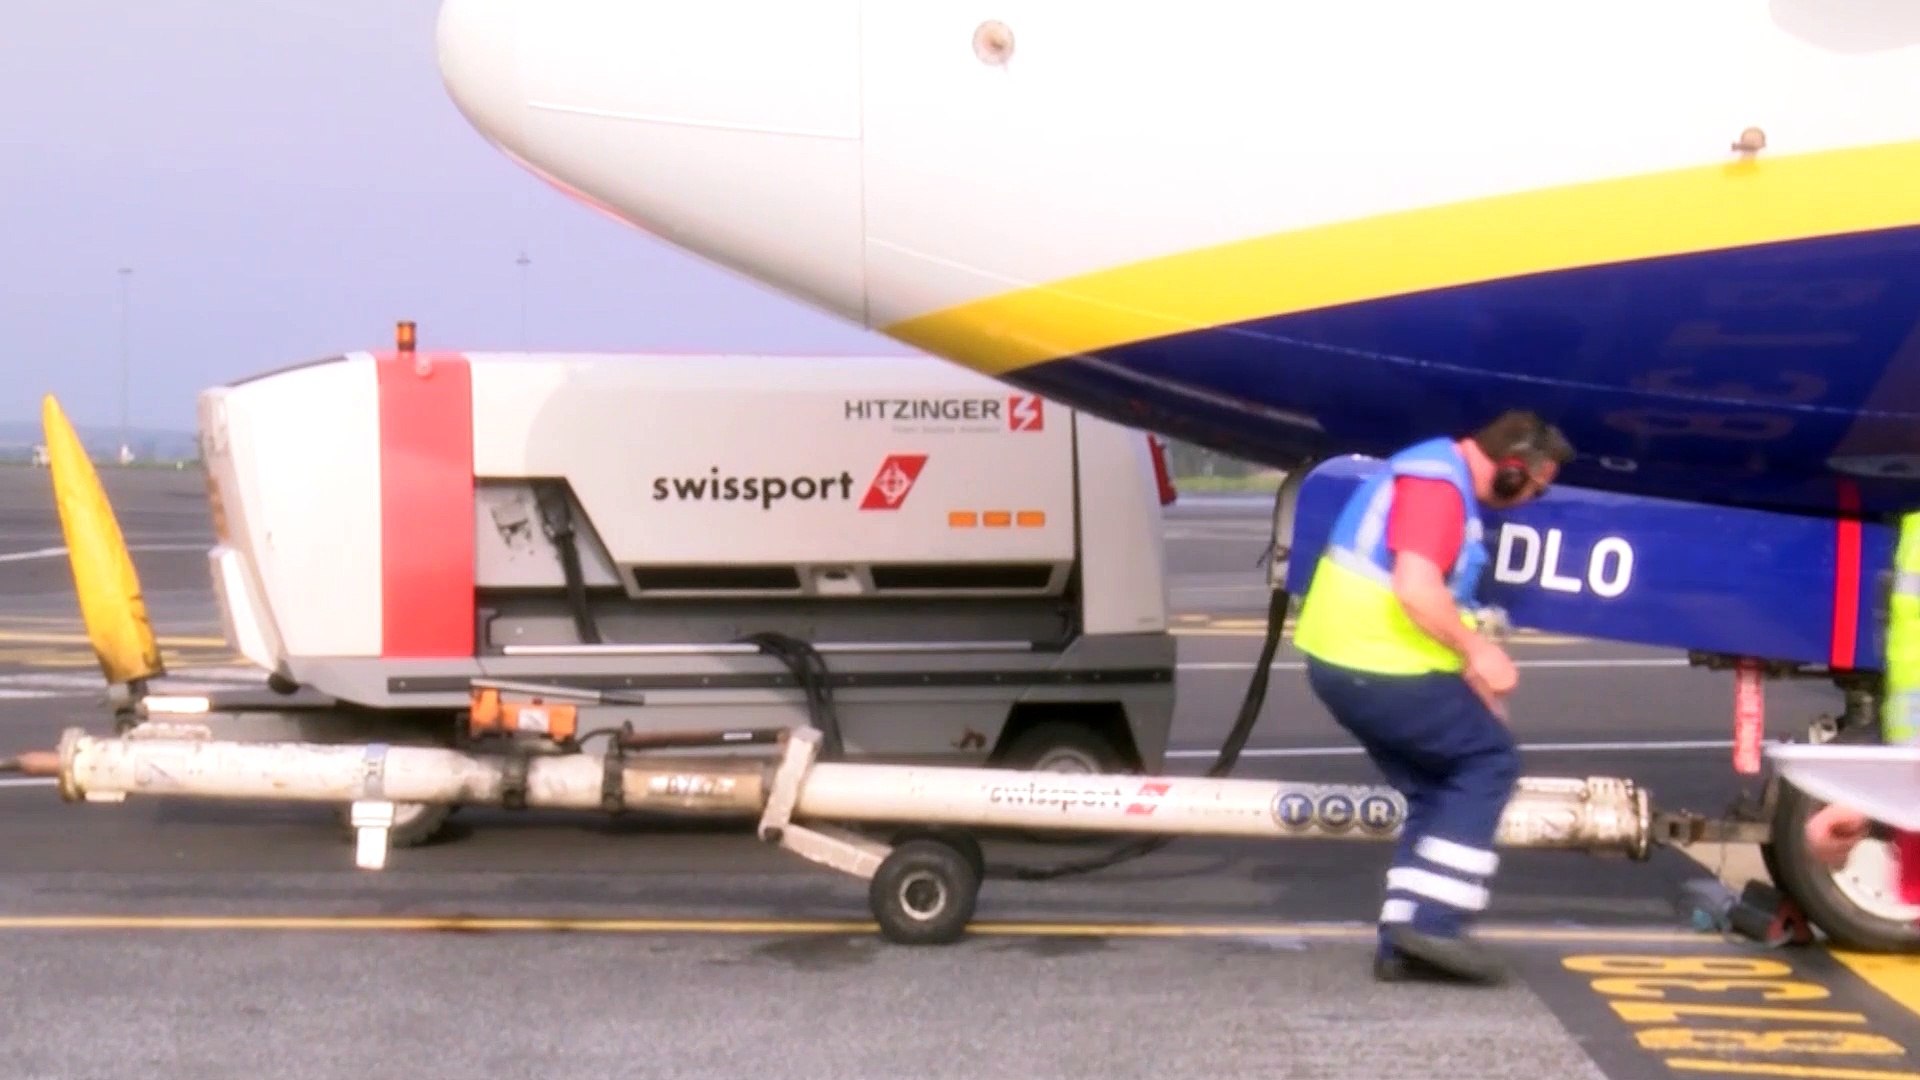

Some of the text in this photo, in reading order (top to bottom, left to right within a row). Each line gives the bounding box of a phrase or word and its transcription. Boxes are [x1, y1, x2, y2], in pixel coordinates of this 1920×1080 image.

[844, 398, 1001, 420] HITZINGER
[652, 466, 854, 510] swissport
[1494, 522, 1634, 598] DLO
[1281, 795, 1394, 826] TCR
